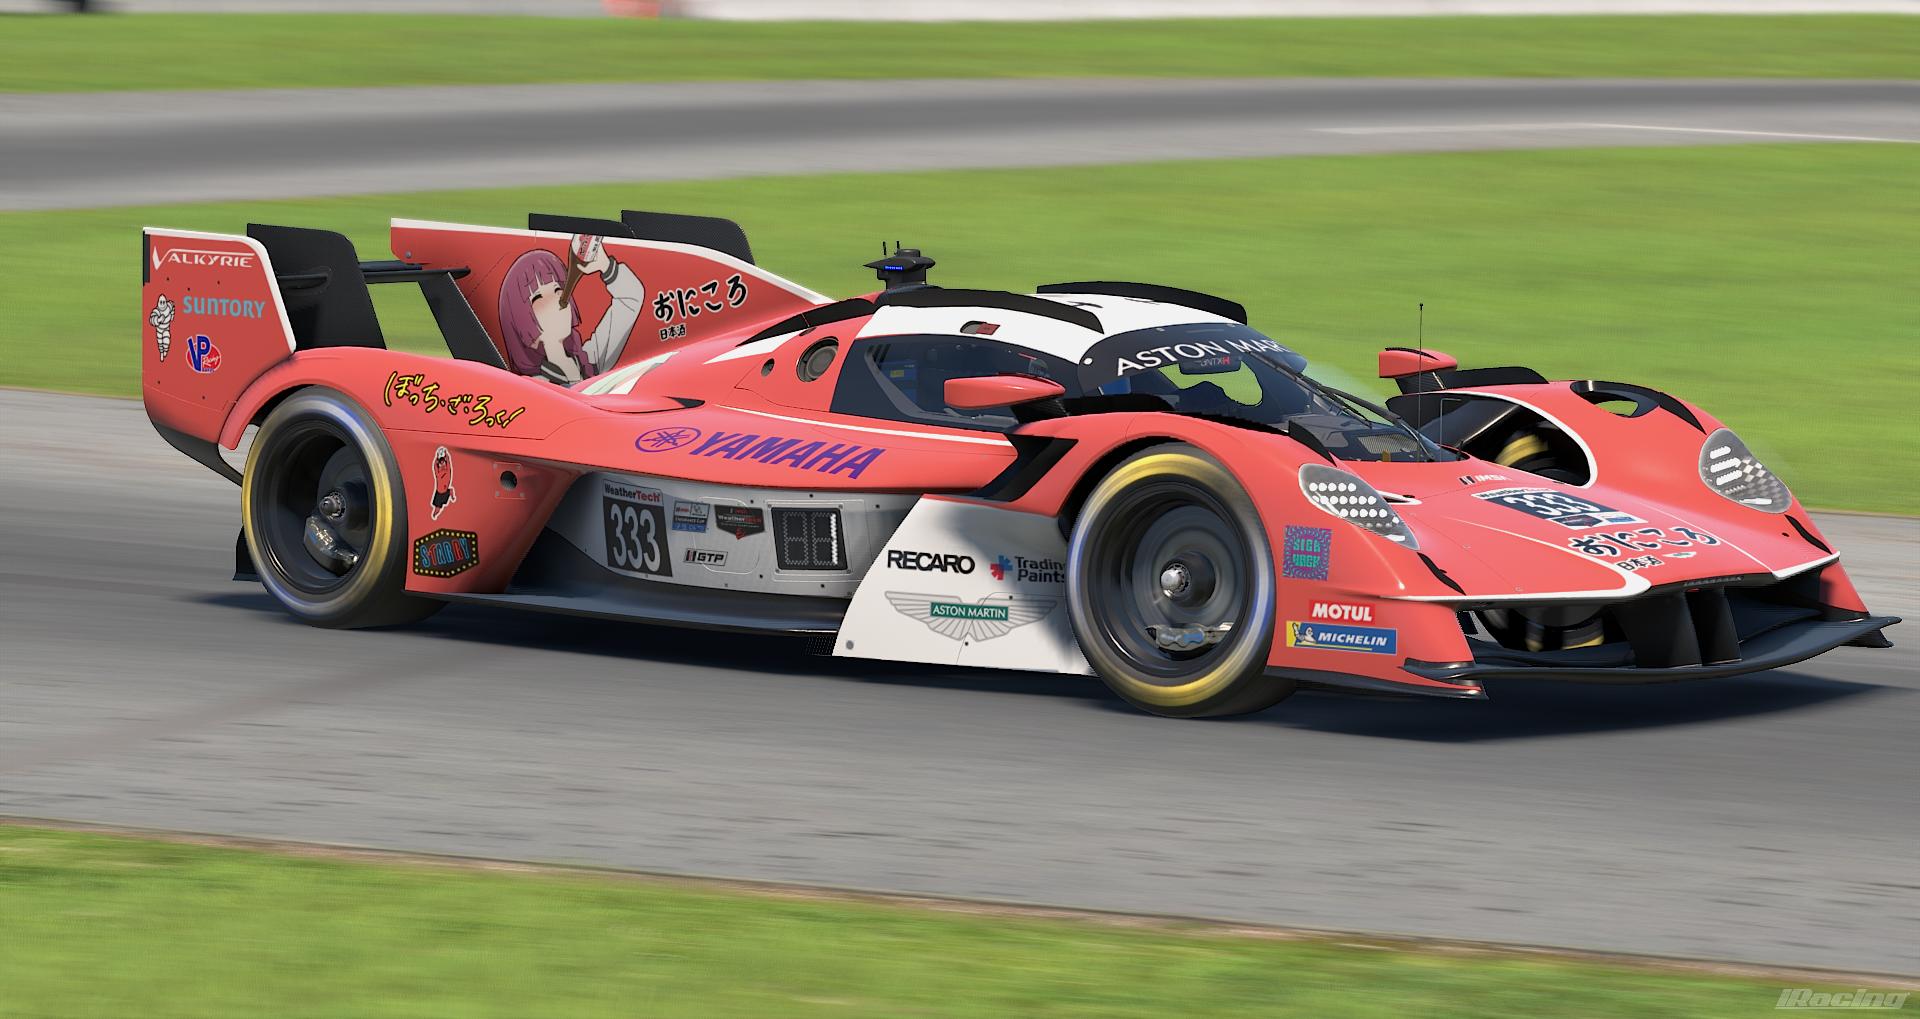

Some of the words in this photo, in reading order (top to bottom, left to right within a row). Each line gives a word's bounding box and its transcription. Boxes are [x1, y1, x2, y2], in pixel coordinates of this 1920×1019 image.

[152, 246, 255, 270] VALKYRIE
[653, 273, 748, 323] おにころ
[659, 323, 687, 341] 日本酒
[187, 335, 211, 372] VP
[1117, 340, 1231, 377] ASTON
[688, 431, 886, 480] YAMAHA
[604, 483, 661, 503] WeatherTech
[1502, 493, 1602, 517] 333
[610, 503, 661, 573] 333
[1567, 526, 1721, 557] おにころ
[697, 552, 725, 563] GTP
[887, 549, 976, 575] RECARO
[1014, 555, 1065, 571] Tradin
[932, 604, 966, 617] ASTON
[967, 606, 1007, 619] MARTIN
[1311, 602, 1373, 622] MOTUL
[1318, 632, 1388, 646] MICHELIN
